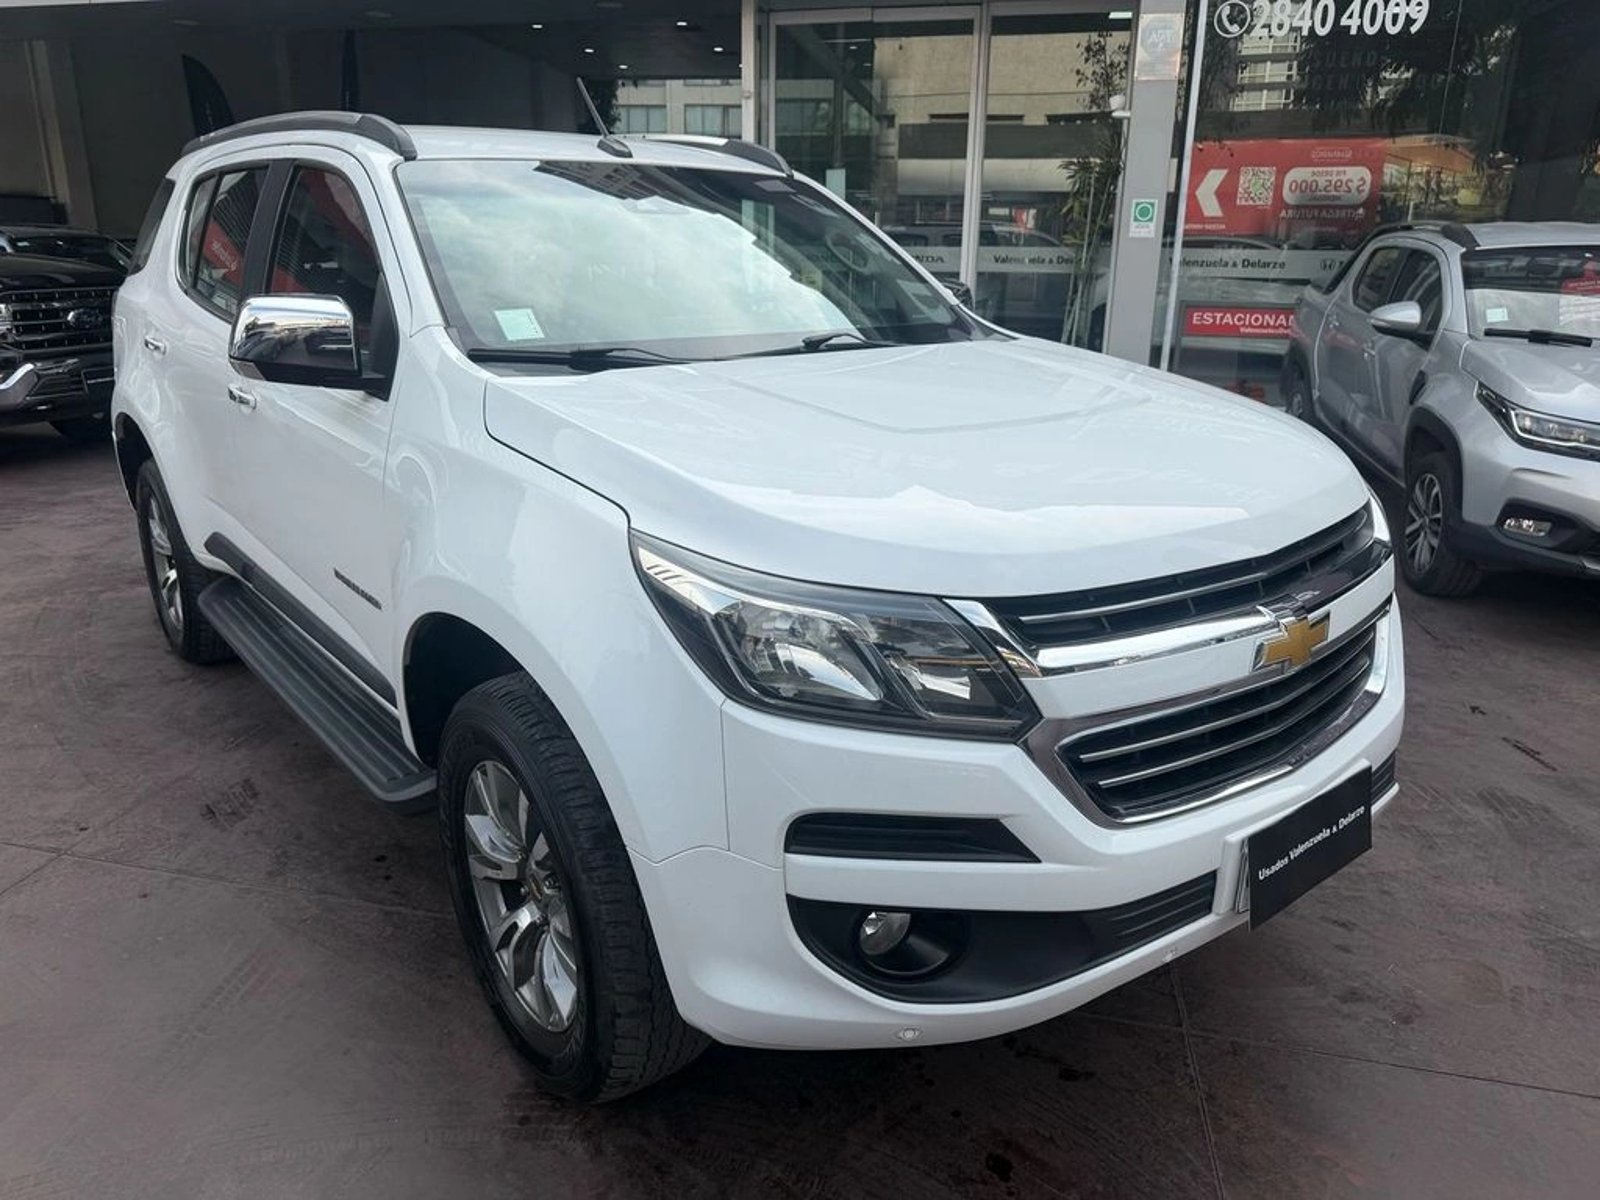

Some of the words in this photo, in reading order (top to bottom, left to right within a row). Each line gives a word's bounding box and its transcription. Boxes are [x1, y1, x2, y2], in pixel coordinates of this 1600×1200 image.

[1252, 0, 1336, 37] 2840
[1340, 0, 1430, 36] 4009
[912, 254, 945, 263] NDA
[993, 254, 1046, 265] Valenela
[1169, 257, 1230, 268] lenzuela
[1258, 855, 1289, 880] Usados
[1289, 827, 1331, 860] Valenzuela
[1338, 805, 1365, 830] Delarze
